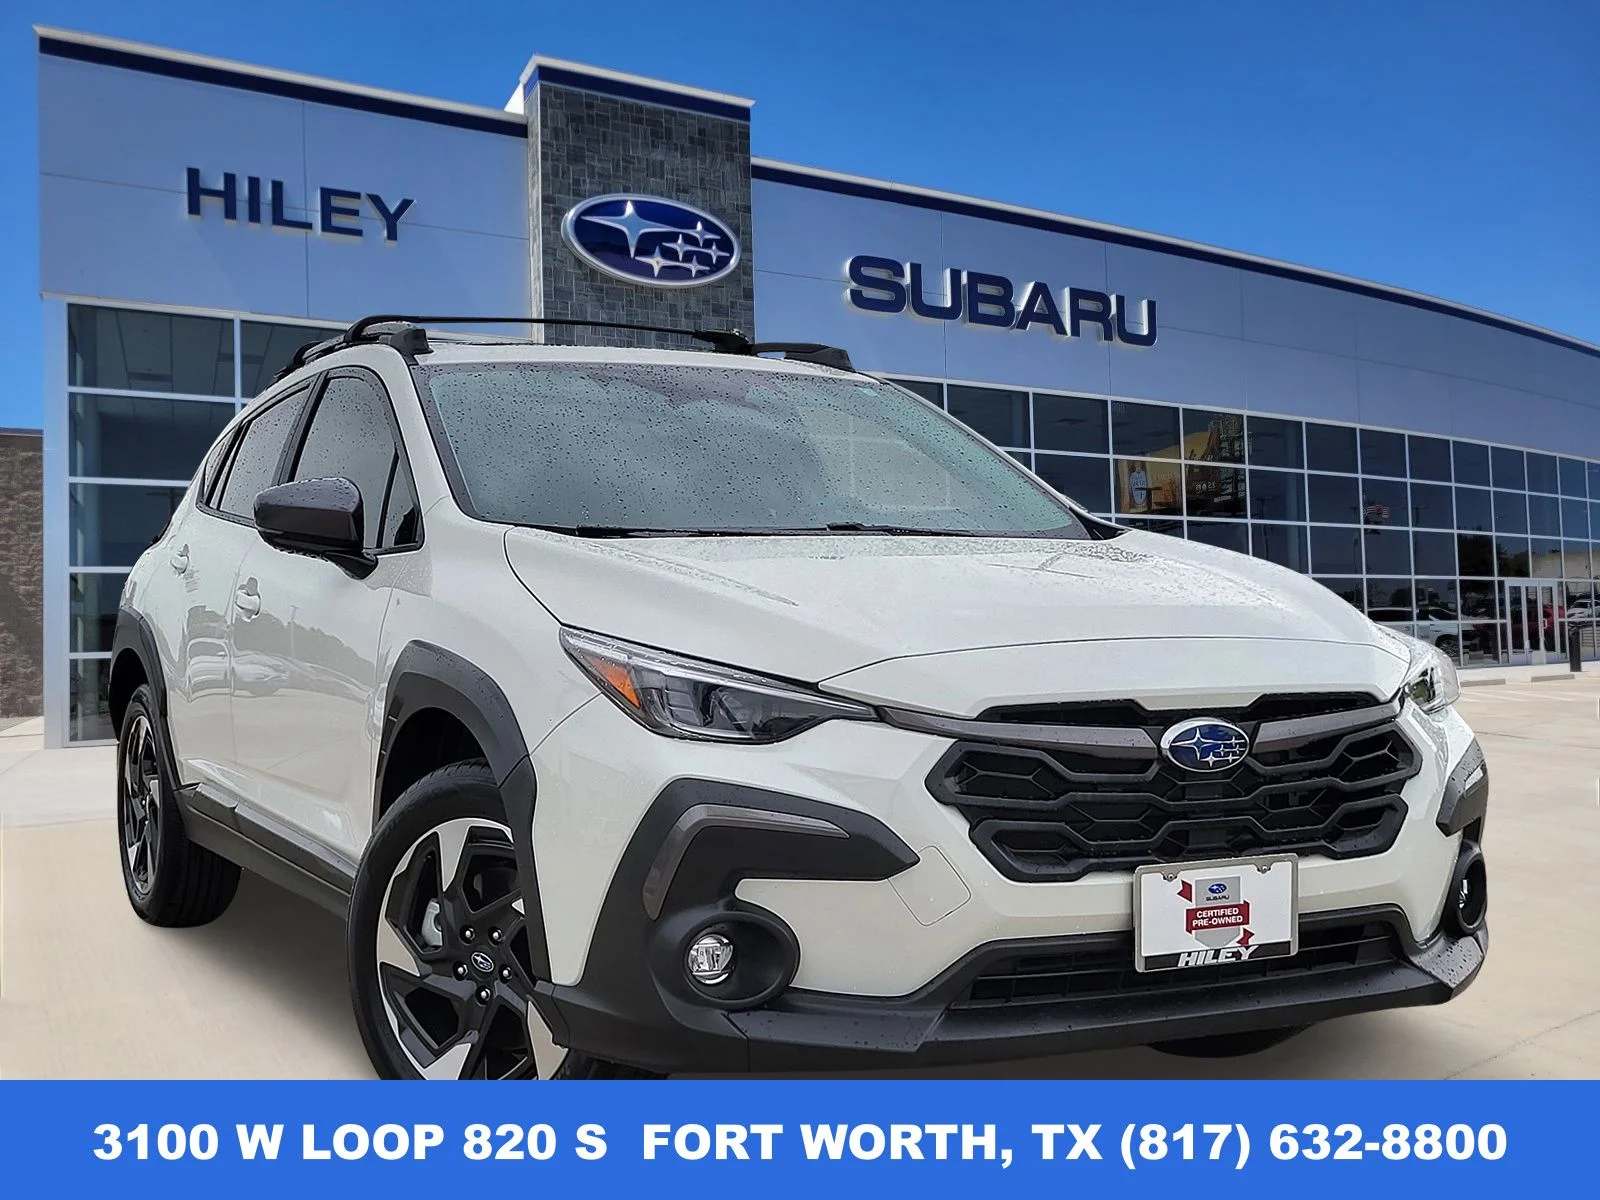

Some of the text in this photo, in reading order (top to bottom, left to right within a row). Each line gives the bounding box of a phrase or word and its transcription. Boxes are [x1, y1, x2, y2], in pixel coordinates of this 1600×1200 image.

[186, 166, 416, 242] HILEY
[847, 254, 1158, 347] SUBARU
[1192, 915, 1243, 927] PRE-OWNED
[1196, 907, 1239, 918] CERTIFIED
[1177, 945, 1259, 968] HILEY
